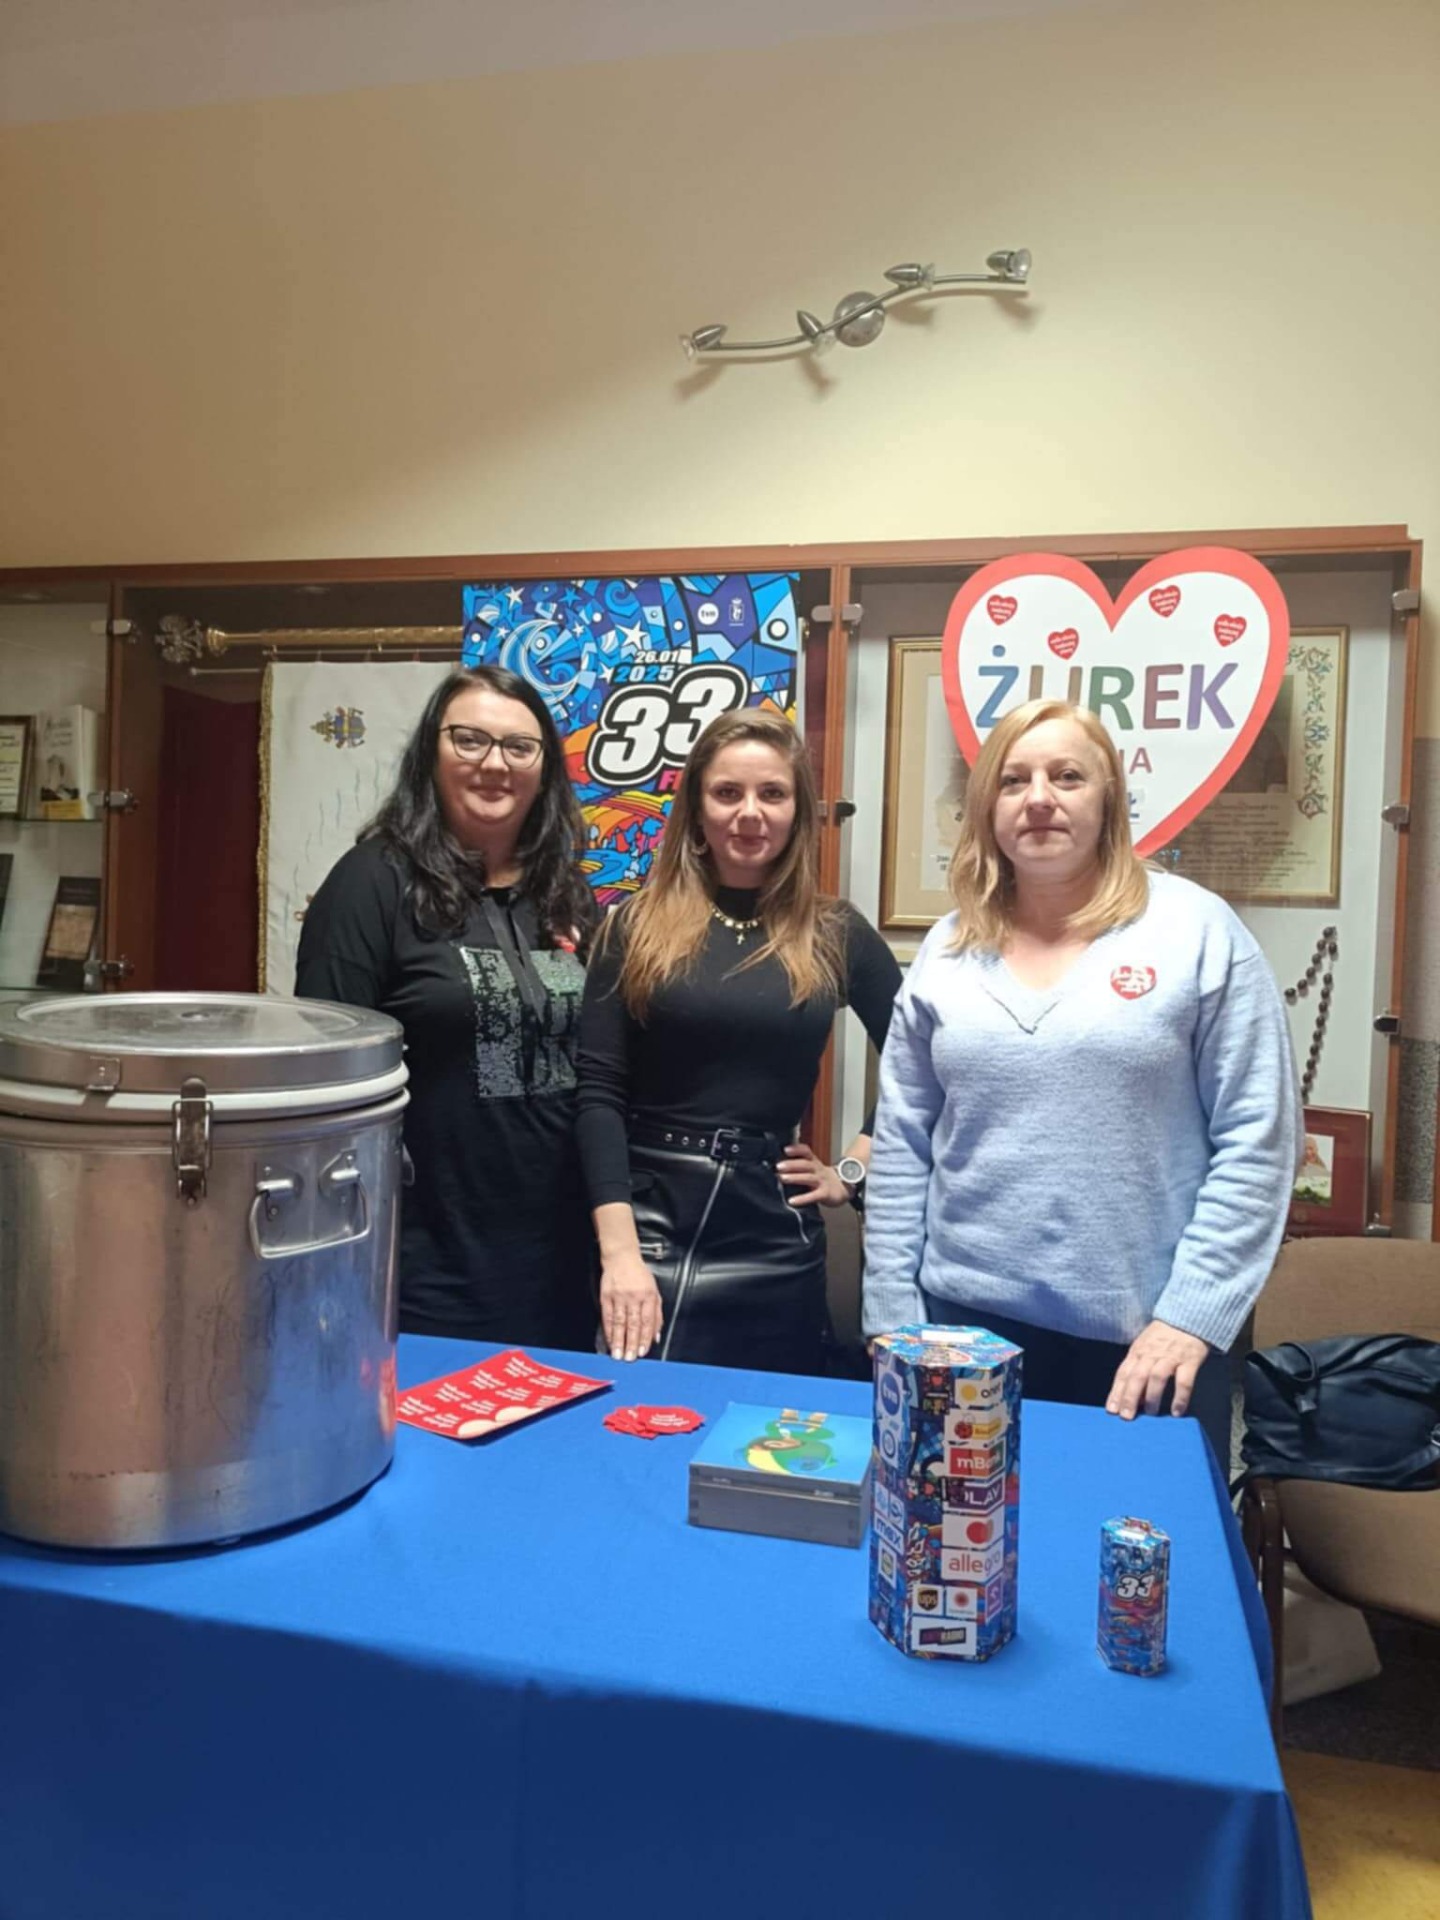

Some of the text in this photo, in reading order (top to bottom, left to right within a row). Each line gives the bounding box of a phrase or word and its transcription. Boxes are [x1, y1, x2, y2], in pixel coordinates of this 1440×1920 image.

[634, 650, 680, 664] 26.01
[614, 664, 676, 683] 2025
[597, 672, 741, 776] 33
[1117, 1575, 1155, 1599] 33
